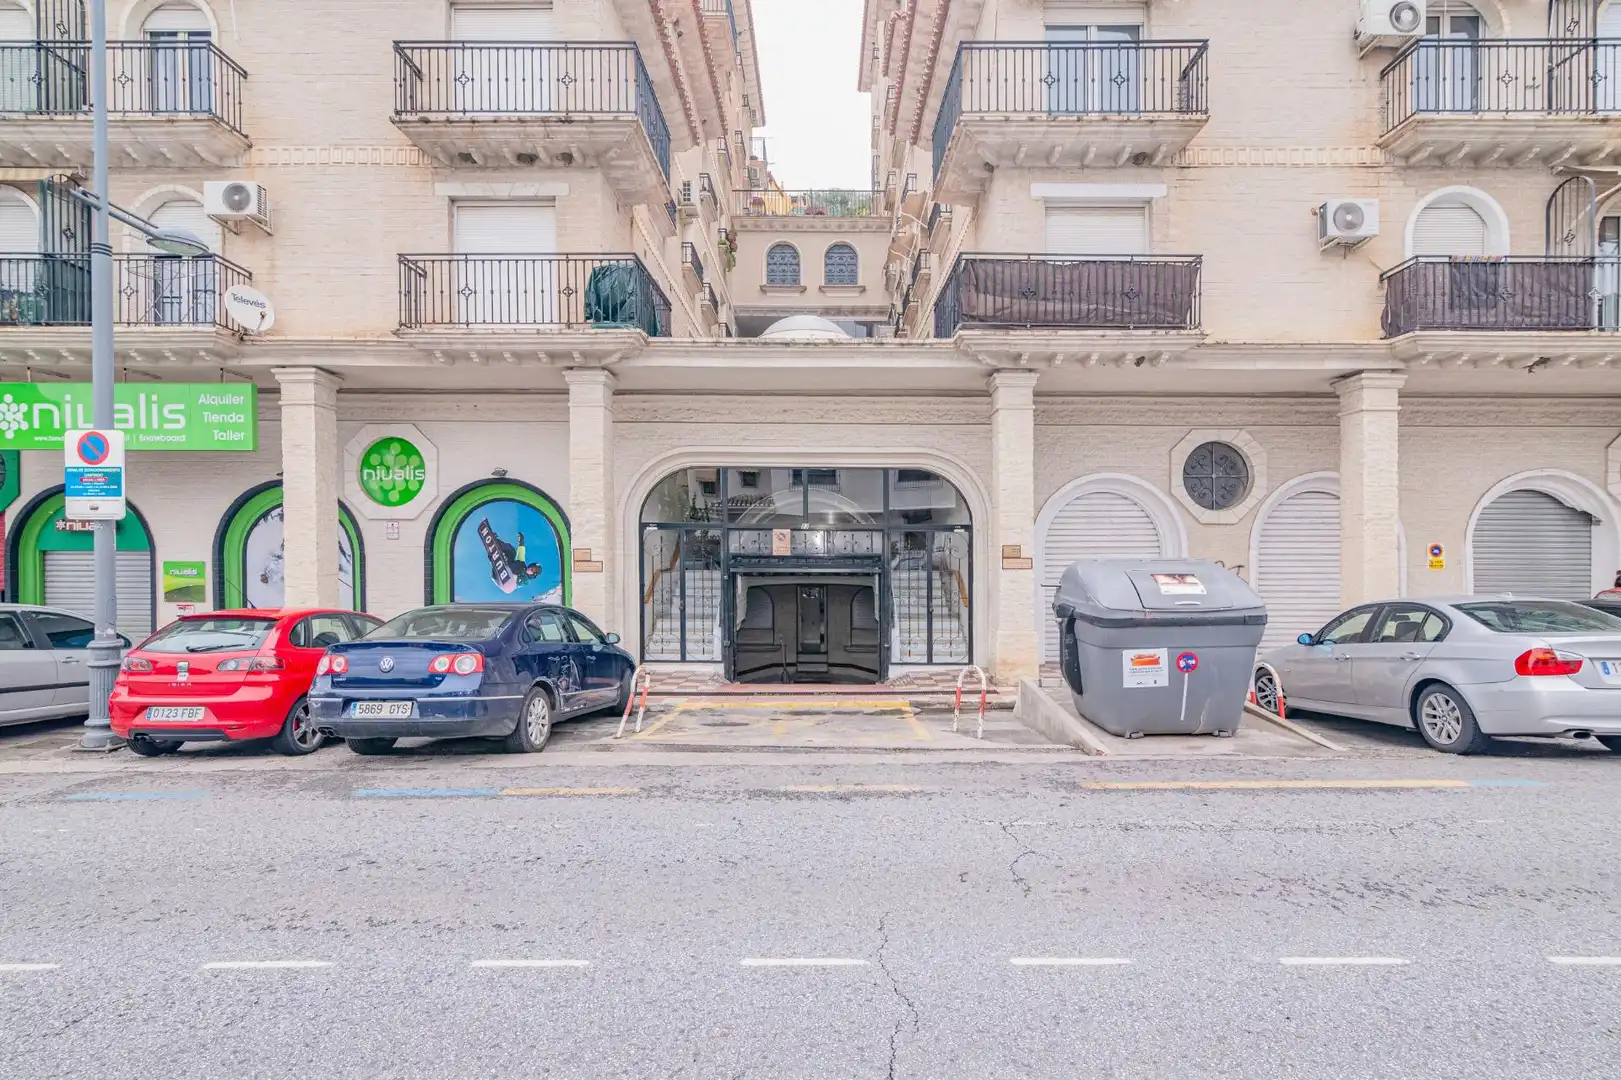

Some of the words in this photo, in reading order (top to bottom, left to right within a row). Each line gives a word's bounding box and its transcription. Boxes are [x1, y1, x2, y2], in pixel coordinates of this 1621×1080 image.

[231, 292, 266, 309] Televés
[198, 393, 244, 406] Alquiler
[203, 412, 245, 423] Tienda
[213, 429, 244, 441] Taller
[481, 527, 508, 580] BURTON
[153, 708, 178, 719] 0123
[358, 703, 384, 715] 5869
[389, 703, 409, 715] GYS
